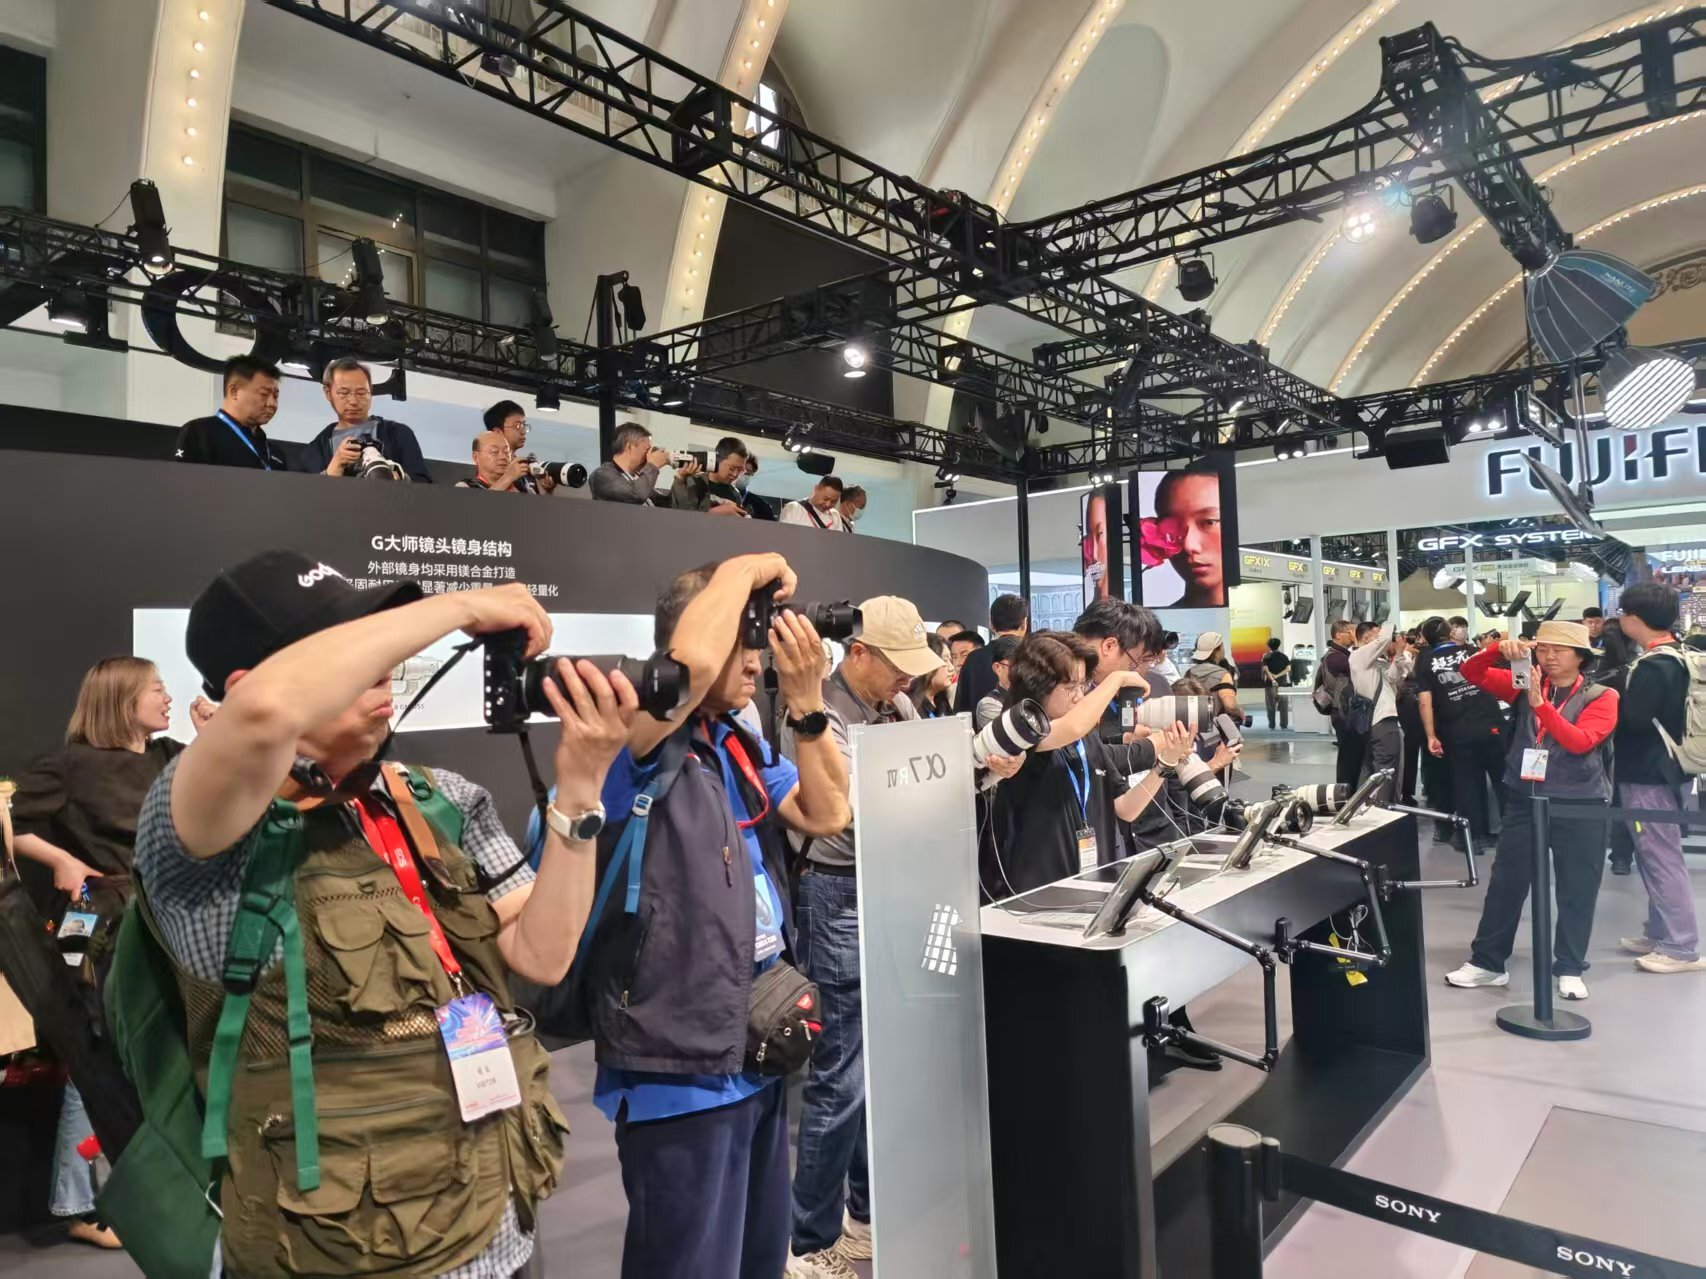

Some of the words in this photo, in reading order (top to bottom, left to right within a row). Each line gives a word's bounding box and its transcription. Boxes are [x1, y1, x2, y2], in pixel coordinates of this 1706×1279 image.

[371, 534, 513, 557] G大师镜头镜身结构
[1417, 534, 1483, 551] GFX
[368, 560, 516, 579] 外部镜身均采用镁合金打造
[1374, 1194, 1442, 1224] SONY
[1556, 1245, 1636, 1277] SONY
